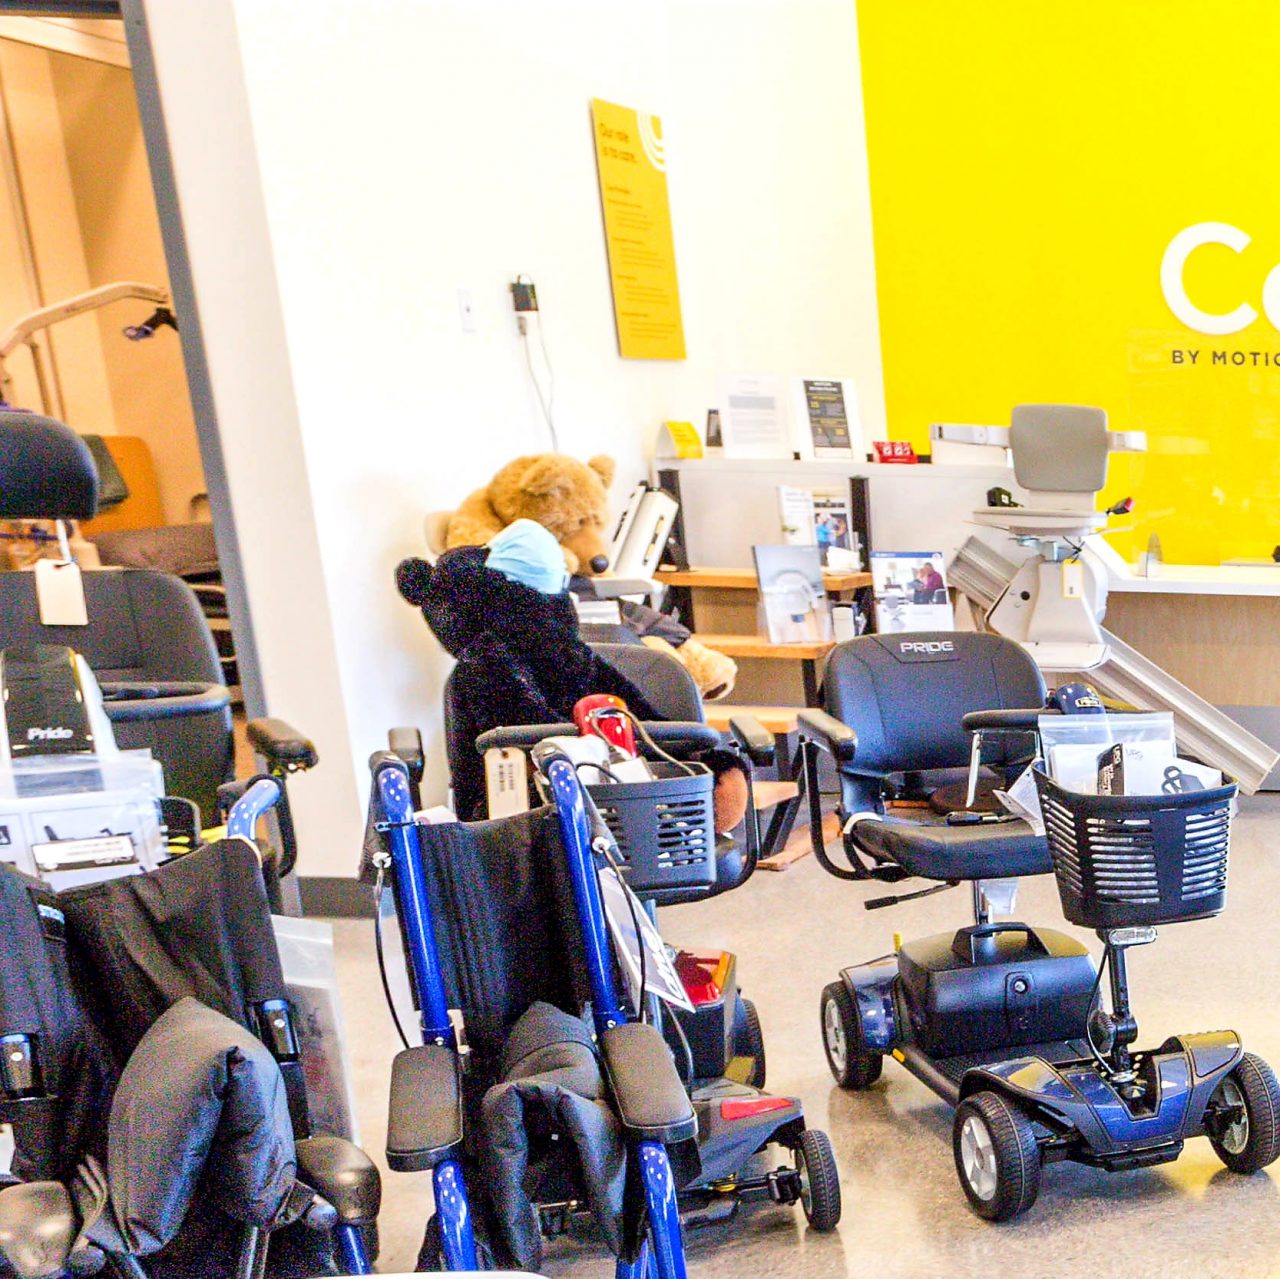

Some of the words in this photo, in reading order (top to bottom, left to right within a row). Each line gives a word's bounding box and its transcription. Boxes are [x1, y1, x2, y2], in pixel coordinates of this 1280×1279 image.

[1172, 350, 1200, 364] BY
[900, 641, 954, 653] PRIDE
[28, 726, 74, 741] Pride
